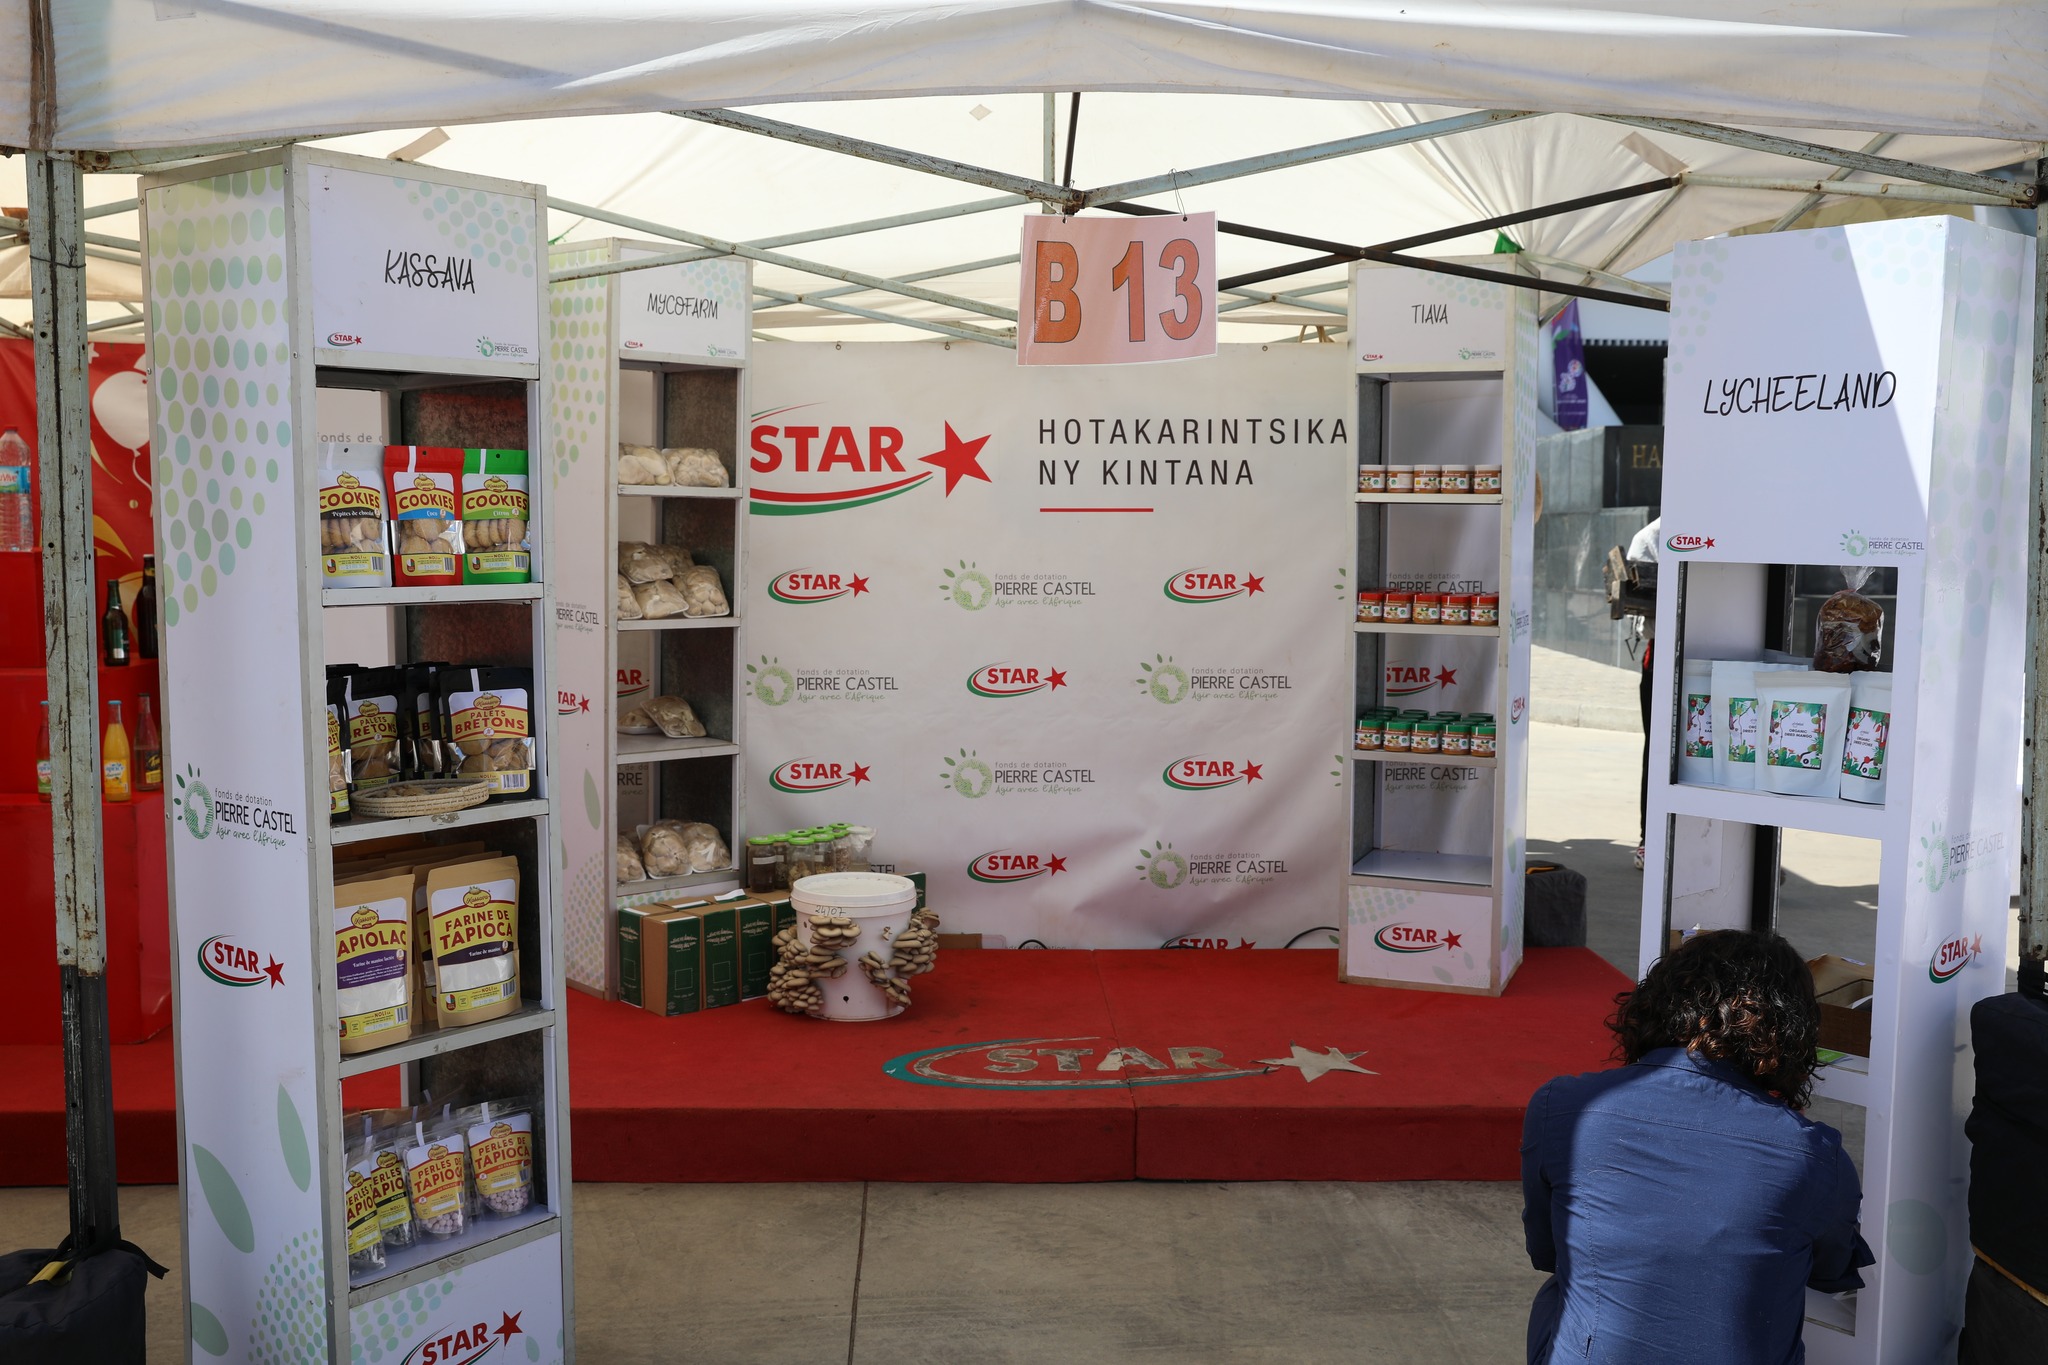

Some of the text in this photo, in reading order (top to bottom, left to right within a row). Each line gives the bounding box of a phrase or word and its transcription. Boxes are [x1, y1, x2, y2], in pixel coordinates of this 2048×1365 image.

[384, 249, 475, 294] KASSAVA
[1034, 238, 1203, 343] B 13
[647, 293, 719, 320] MYCOFARM
[1411, 304, 1449, 325] TIAVA
[334, 334, 353, 342] STAR
[1703, 370, 1897, 416] LYCHEELAND
[318, 432, 373, 443] onds de
[1039, 418, 1347, 445] HOTAKARINTSIKA
[750, 424, 907, 473] STAR
[1039, 459, 1254, 485] NY KINTANA
[399, 494, 454, 511] COOKIES
[465, 494, 528, 511] COOKIES
[1676, 535, 1702, 547] STAR
[1868, 541, 1925, 550] PIERRE CASTEL
[788, 574, 842, 591] STAR
[994, 582, 1096, 596] PIERRE CASTEL
[1184, 573, 1237, 590] STAR
[1437, 580, 1486, 594] CASTEL
[575, 610, 600, 625] CASTEL
[617, 669, 643, 685] AR
[822, 668, 832, 676] de
[987, 668, 1040, 685] STAR
[796, 676, 899, 691] PIERRE CASTEL
[1191, 676, 1292, 689] PIERRE CASTEL
[558, 690, 576, 706] TAR
[360, 716, 386, 726] PALETS
[470, 710, 506, 719] PALETS
[353, 722, 397, 738] RETONS
[455, 717, 525, 735] BRETONS
[790, 763, 842, 780] STAR
[994, 769, 1096, 783] PIERRE CASTEL
[1183, 761, 1235, 777] STAR
[1384, 766, 1480, 781] PIERRE CASTEL
[617, 772, 642, 786] RRE
[214, 787, 273, 807] fonds de dotation
[214, 801, 297, 834] PIERRE CASTEL
[233, 830, 251, 840] avec
[1950, 841, 1975, 866] PIERRE
[1976, 832, 2004, 857] CASTEL
[988, 855, 1040, 871] STAR
[1189, 860, 1288, 875] PIERRE CASTEL
[444, 909, 510, 932] FARINE DE
[440, 921, 513, 950] TAPIOCA
[1392, 926, 1438, 944] STAR
[214, 941, 260, 974] STAR
[1940, 936, 1969, 966] STAR
[985, 1045, 1238, 1074] STAR
[478, 1136, 526, 1156] PERLES DE
[474, 1146, 530, 1170] TAPIOCA
[374, 1167, 401, 1186] ERLES
[418, 1159, 452, 1180] PERLES
[347, 1186, 369, 1206] ERLES
[373, 1178, 404, 1200] APIO
[422, 1322, 489, 1365] STAR
